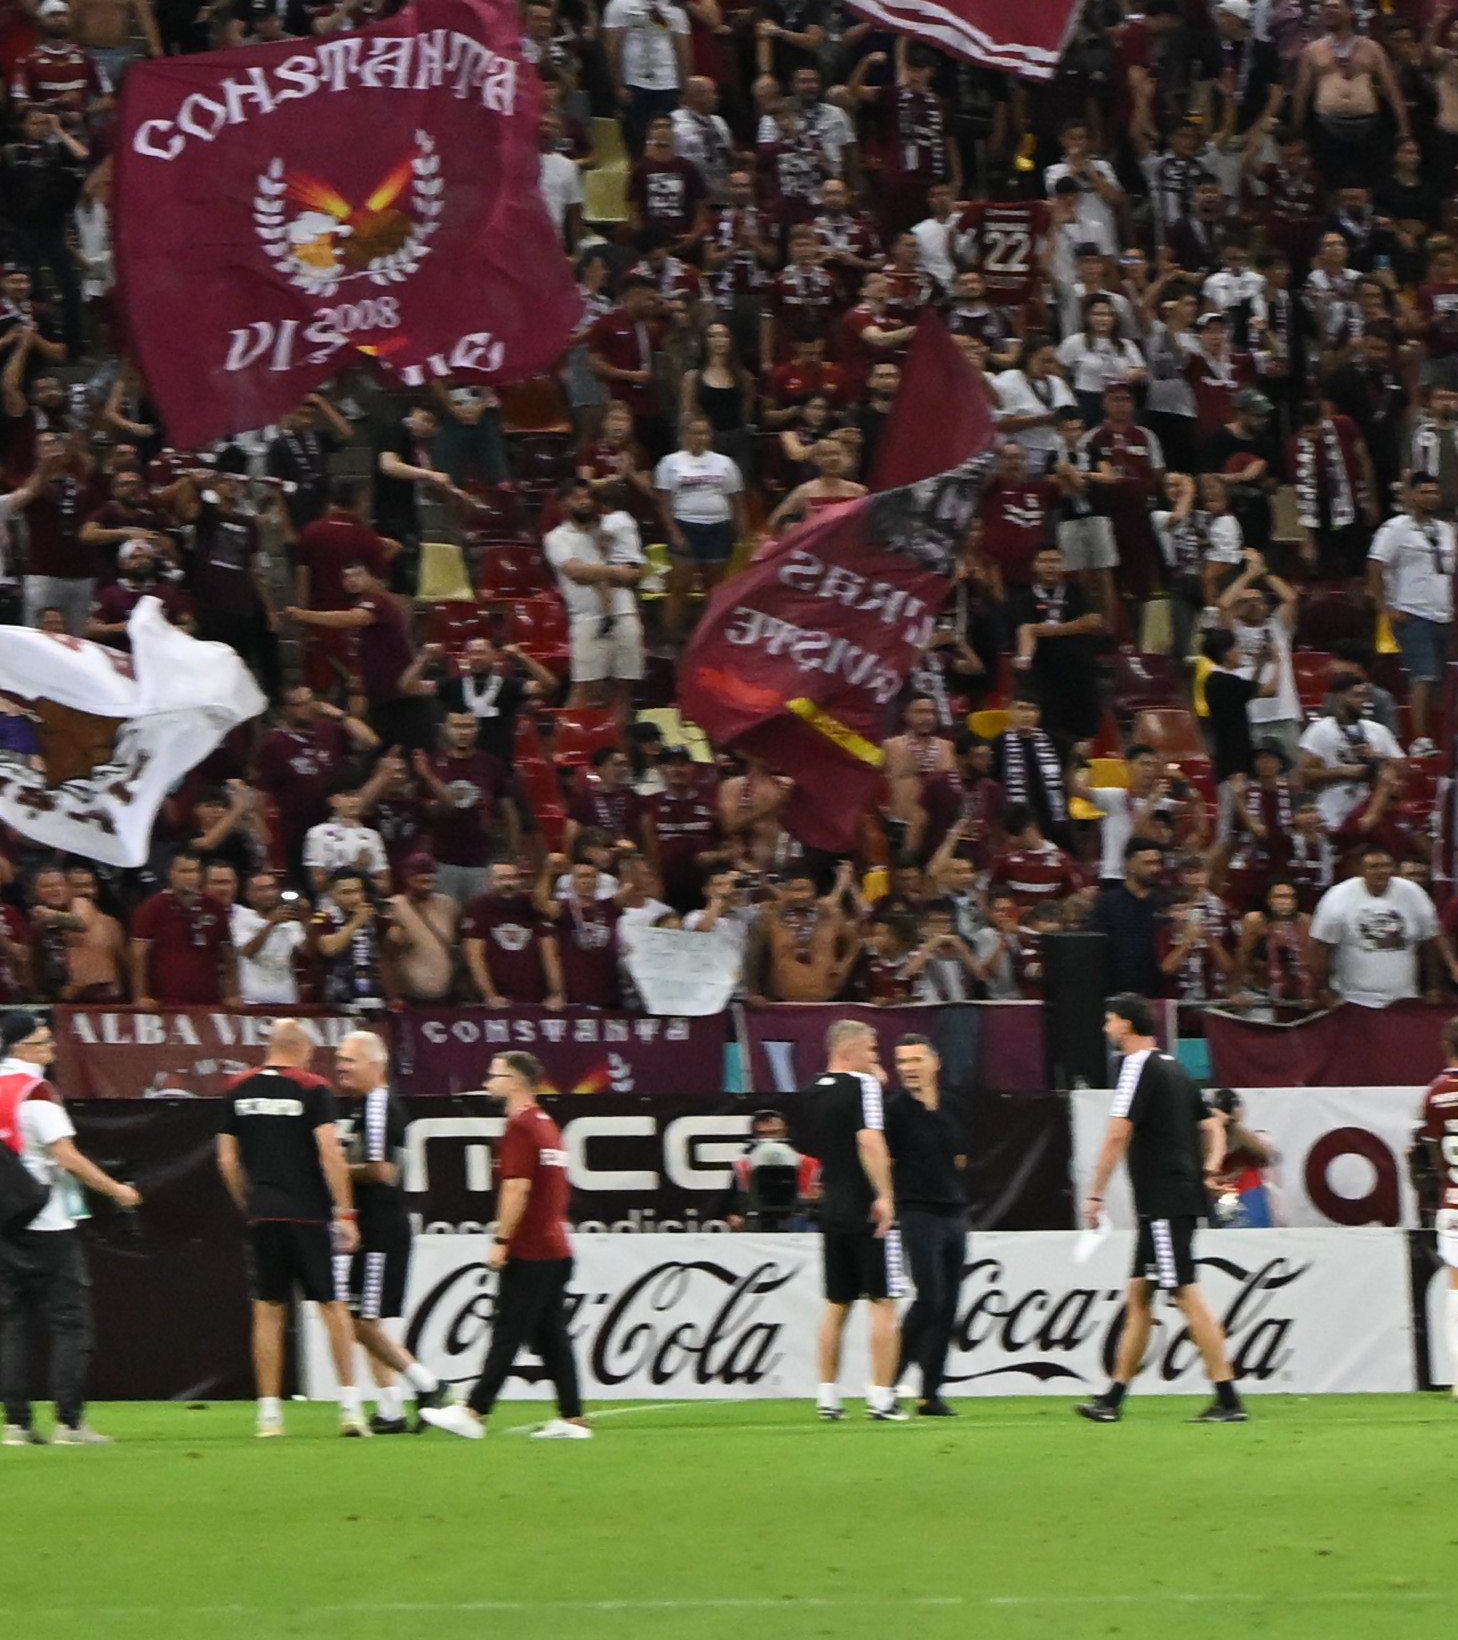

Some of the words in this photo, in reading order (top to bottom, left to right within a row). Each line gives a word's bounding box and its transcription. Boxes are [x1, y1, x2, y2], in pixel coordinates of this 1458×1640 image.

[133, 28, 517, 160] CONSTANTA
[983, 230, 1032, 272] 22
[313, 295, 401, 334] 2008
[71, 1012, 202, 1045] ALBA
[421, 1017, 690, 1044] CONSTANTA
